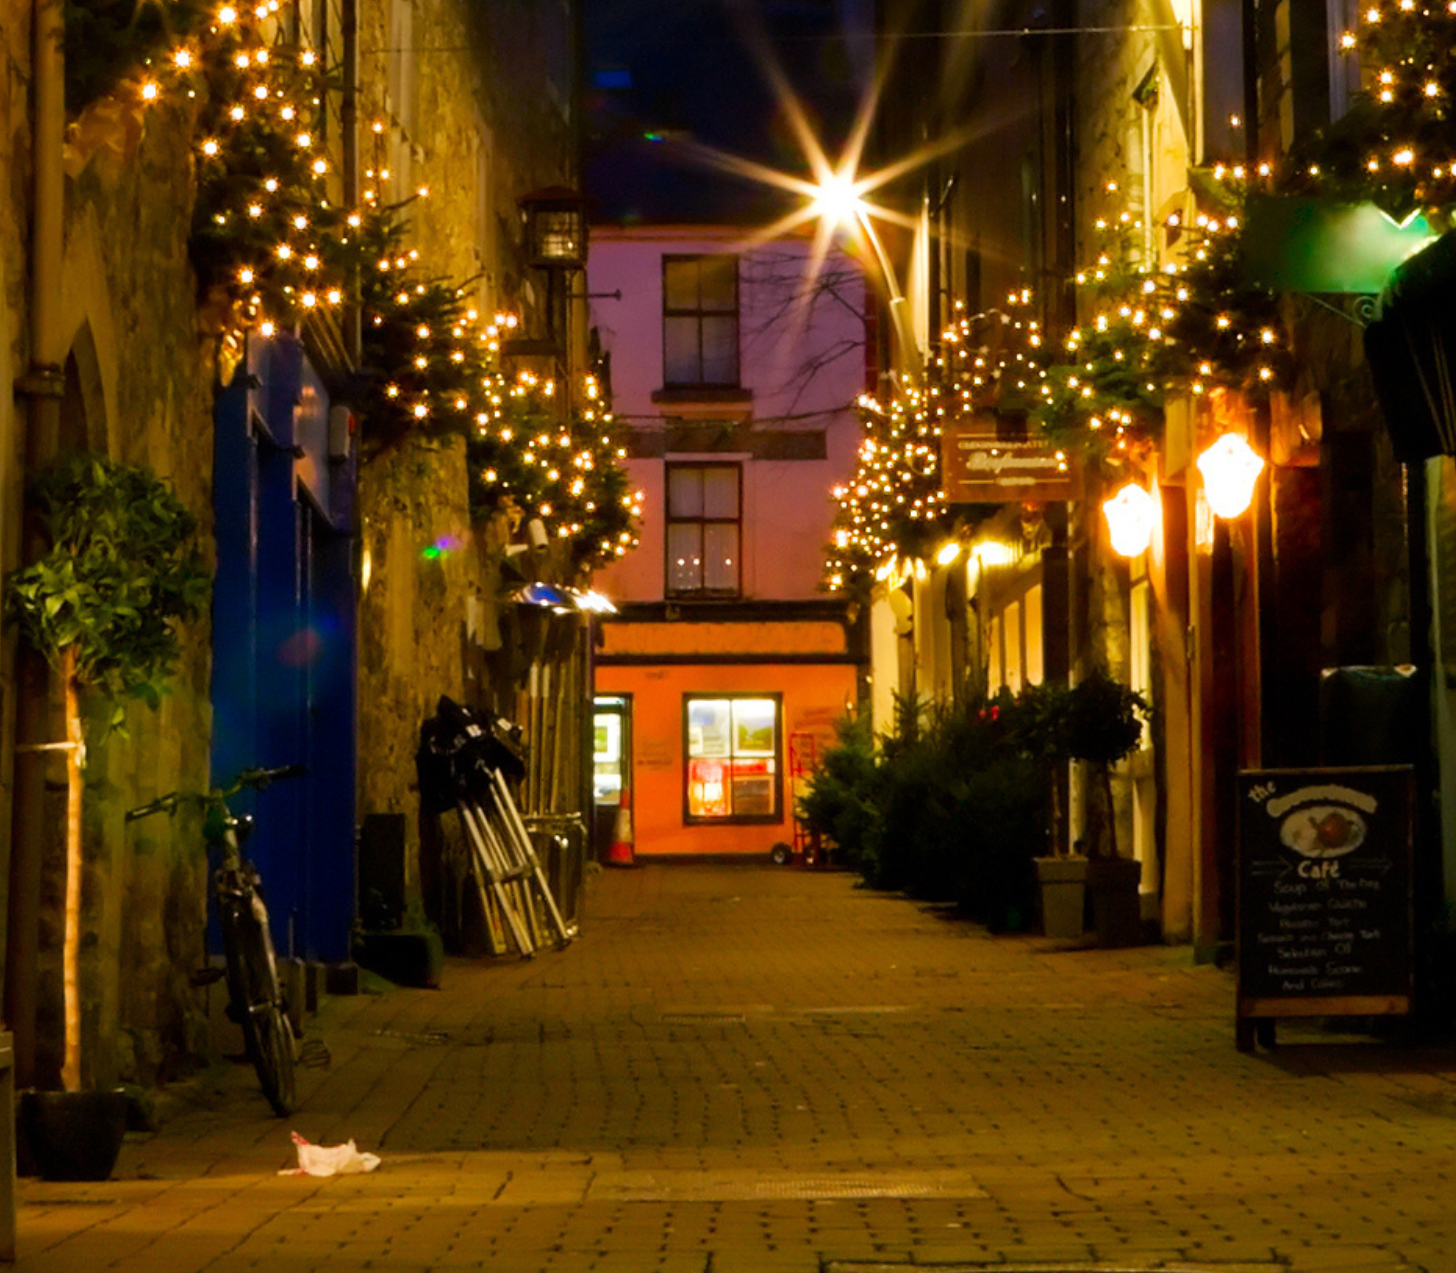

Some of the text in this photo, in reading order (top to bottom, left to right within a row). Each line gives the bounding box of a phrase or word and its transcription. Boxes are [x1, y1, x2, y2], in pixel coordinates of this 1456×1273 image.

[1247, 781, 1276, 803] the
[1297, 859, 1341, 879] Café
[1273, 880, 1307, 896] Soup
